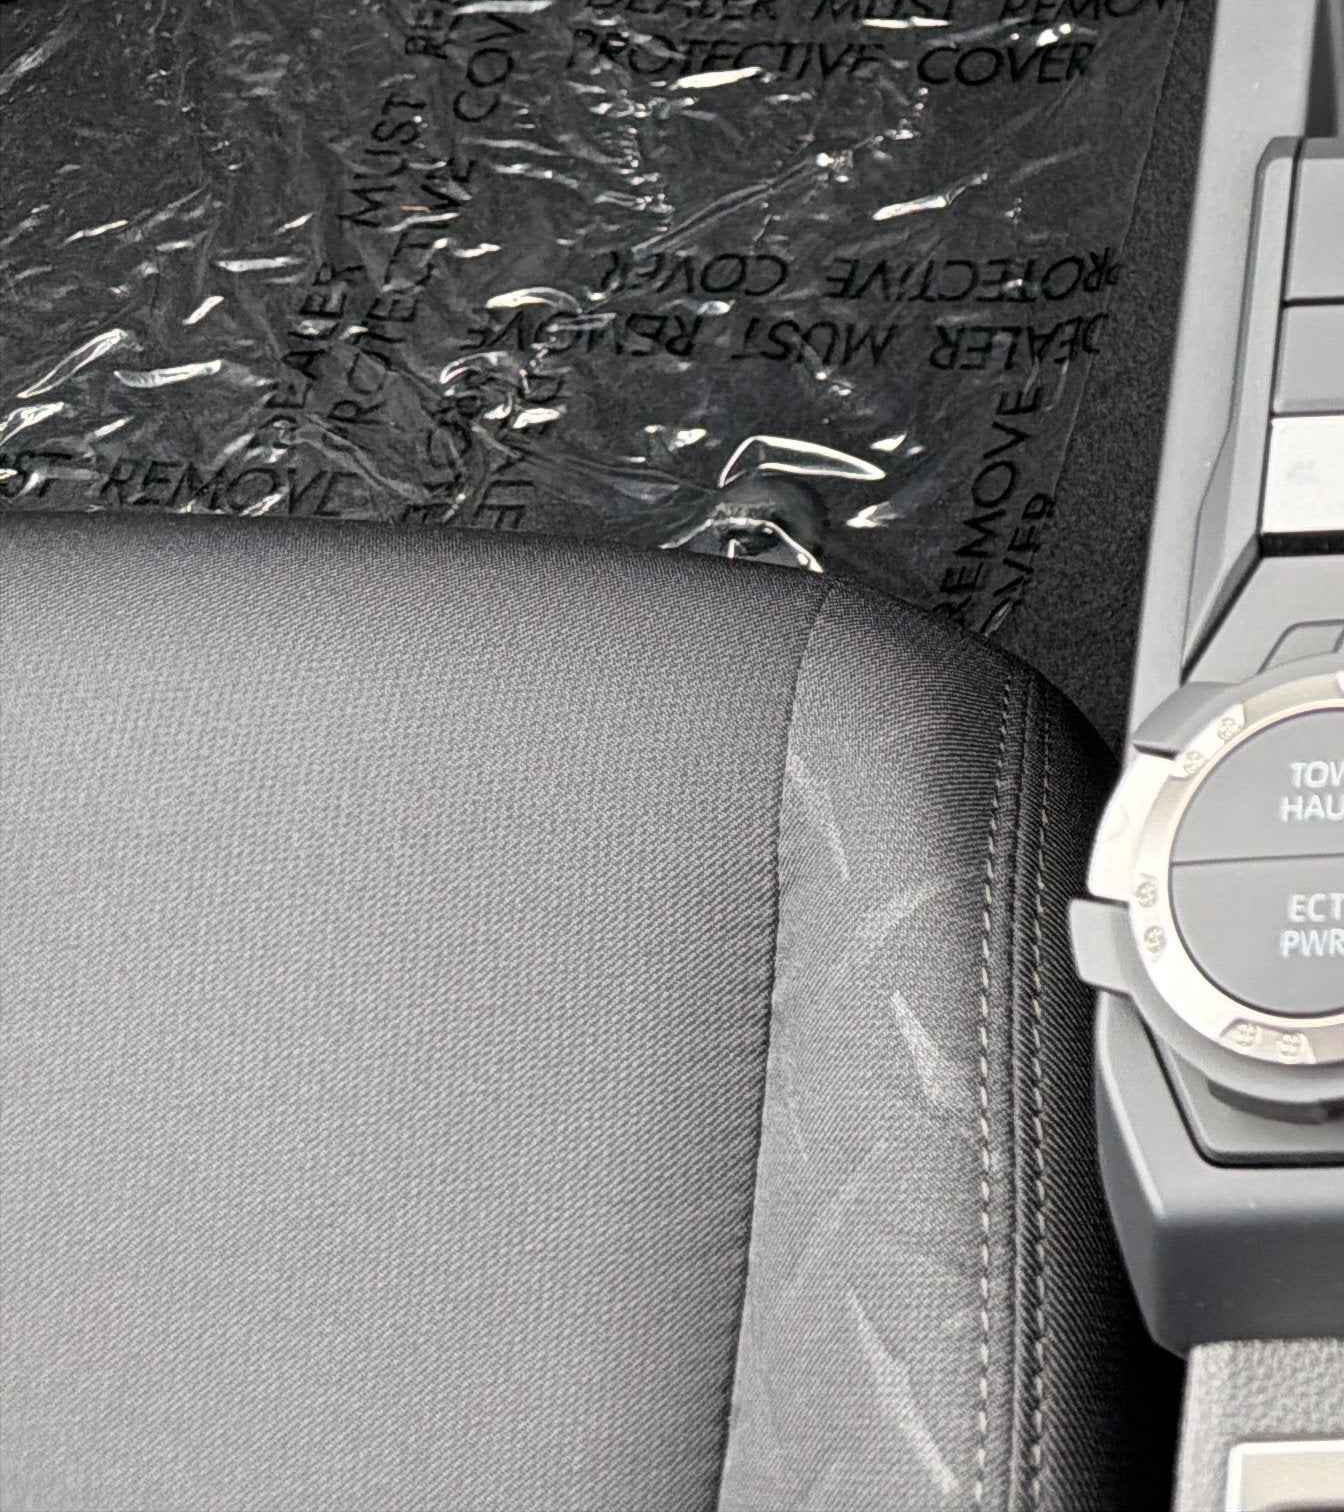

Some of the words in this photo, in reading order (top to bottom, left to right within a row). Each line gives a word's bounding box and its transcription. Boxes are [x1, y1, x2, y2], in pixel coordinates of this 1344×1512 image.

[917, 42, 1098, 87] COVER
[336, 95, 428, 229] MUST
[731, 317, 896, 367] MUST
